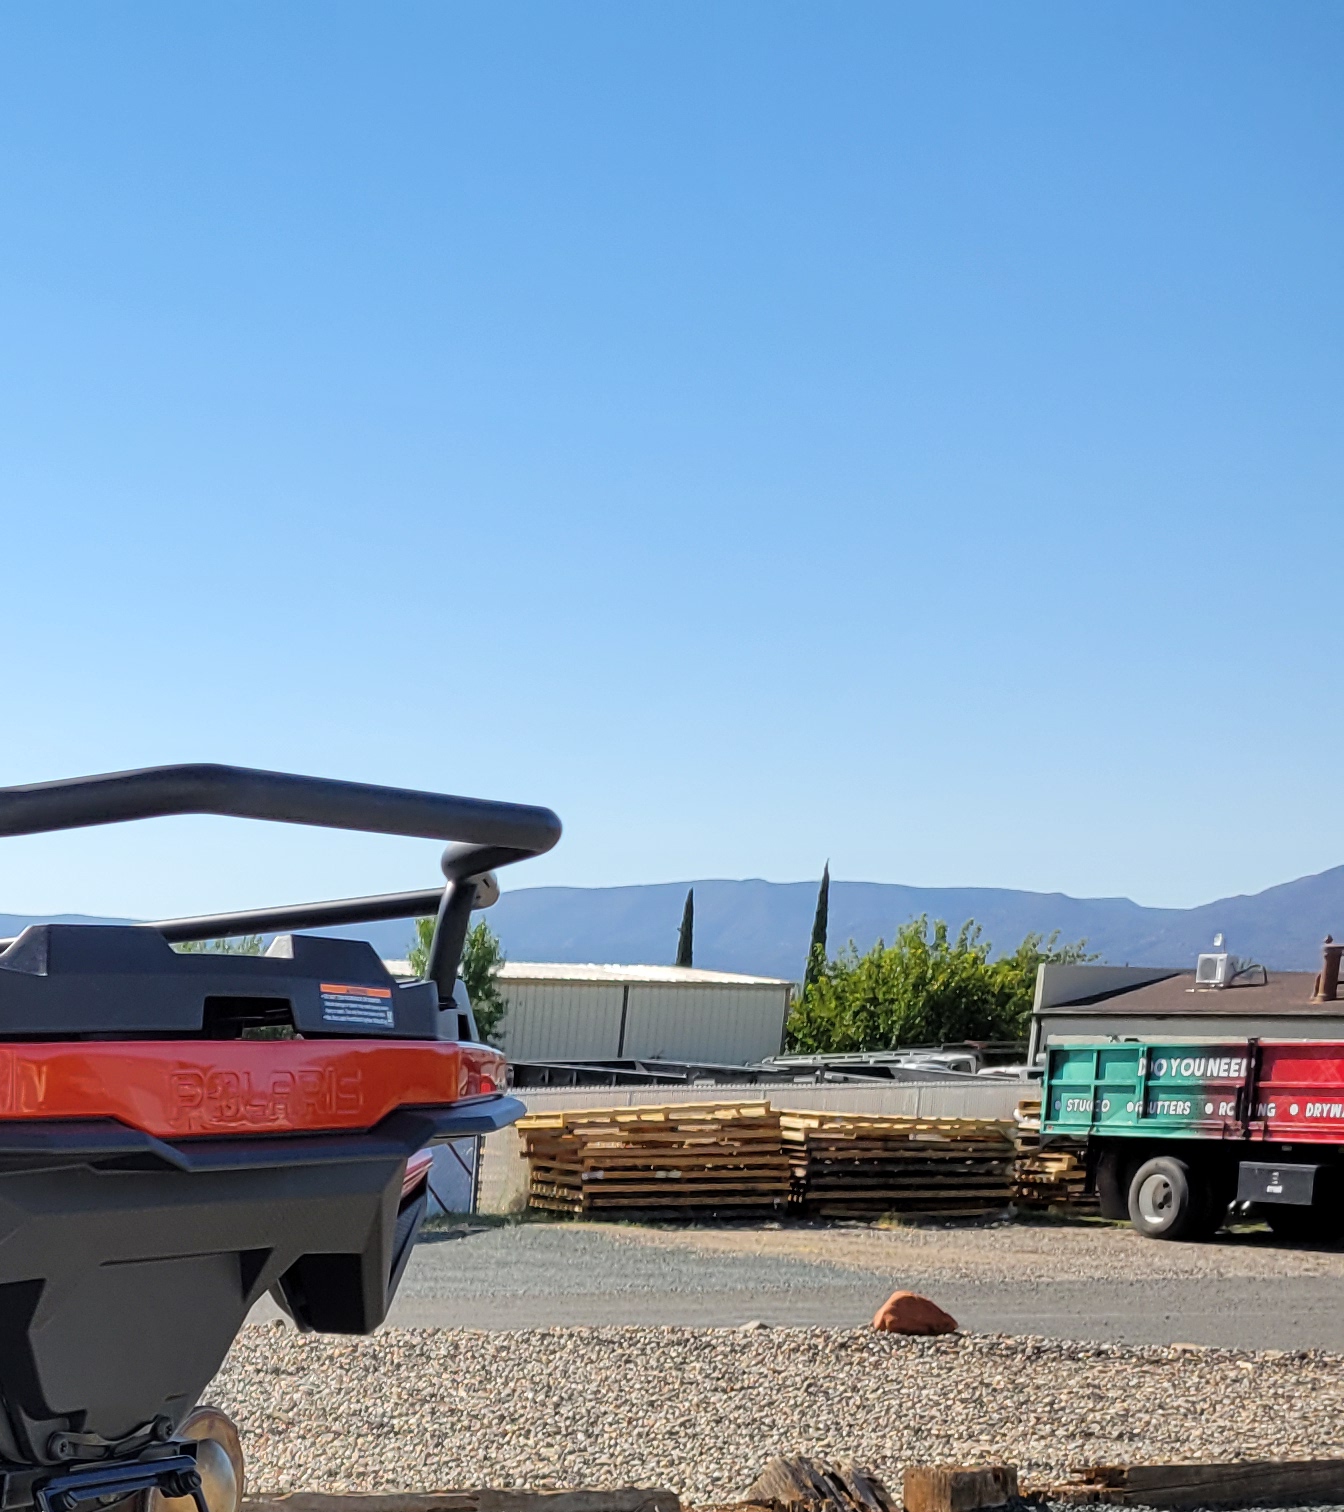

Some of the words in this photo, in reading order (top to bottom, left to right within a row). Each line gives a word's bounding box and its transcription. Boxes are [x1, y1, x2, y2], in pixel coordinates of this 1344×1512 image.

[1170, 1057, 1206, 1077] YOU
[169, 1066, 362, 1120] POLARIS
[1305, 1102, 1344, 1118] DRYW
